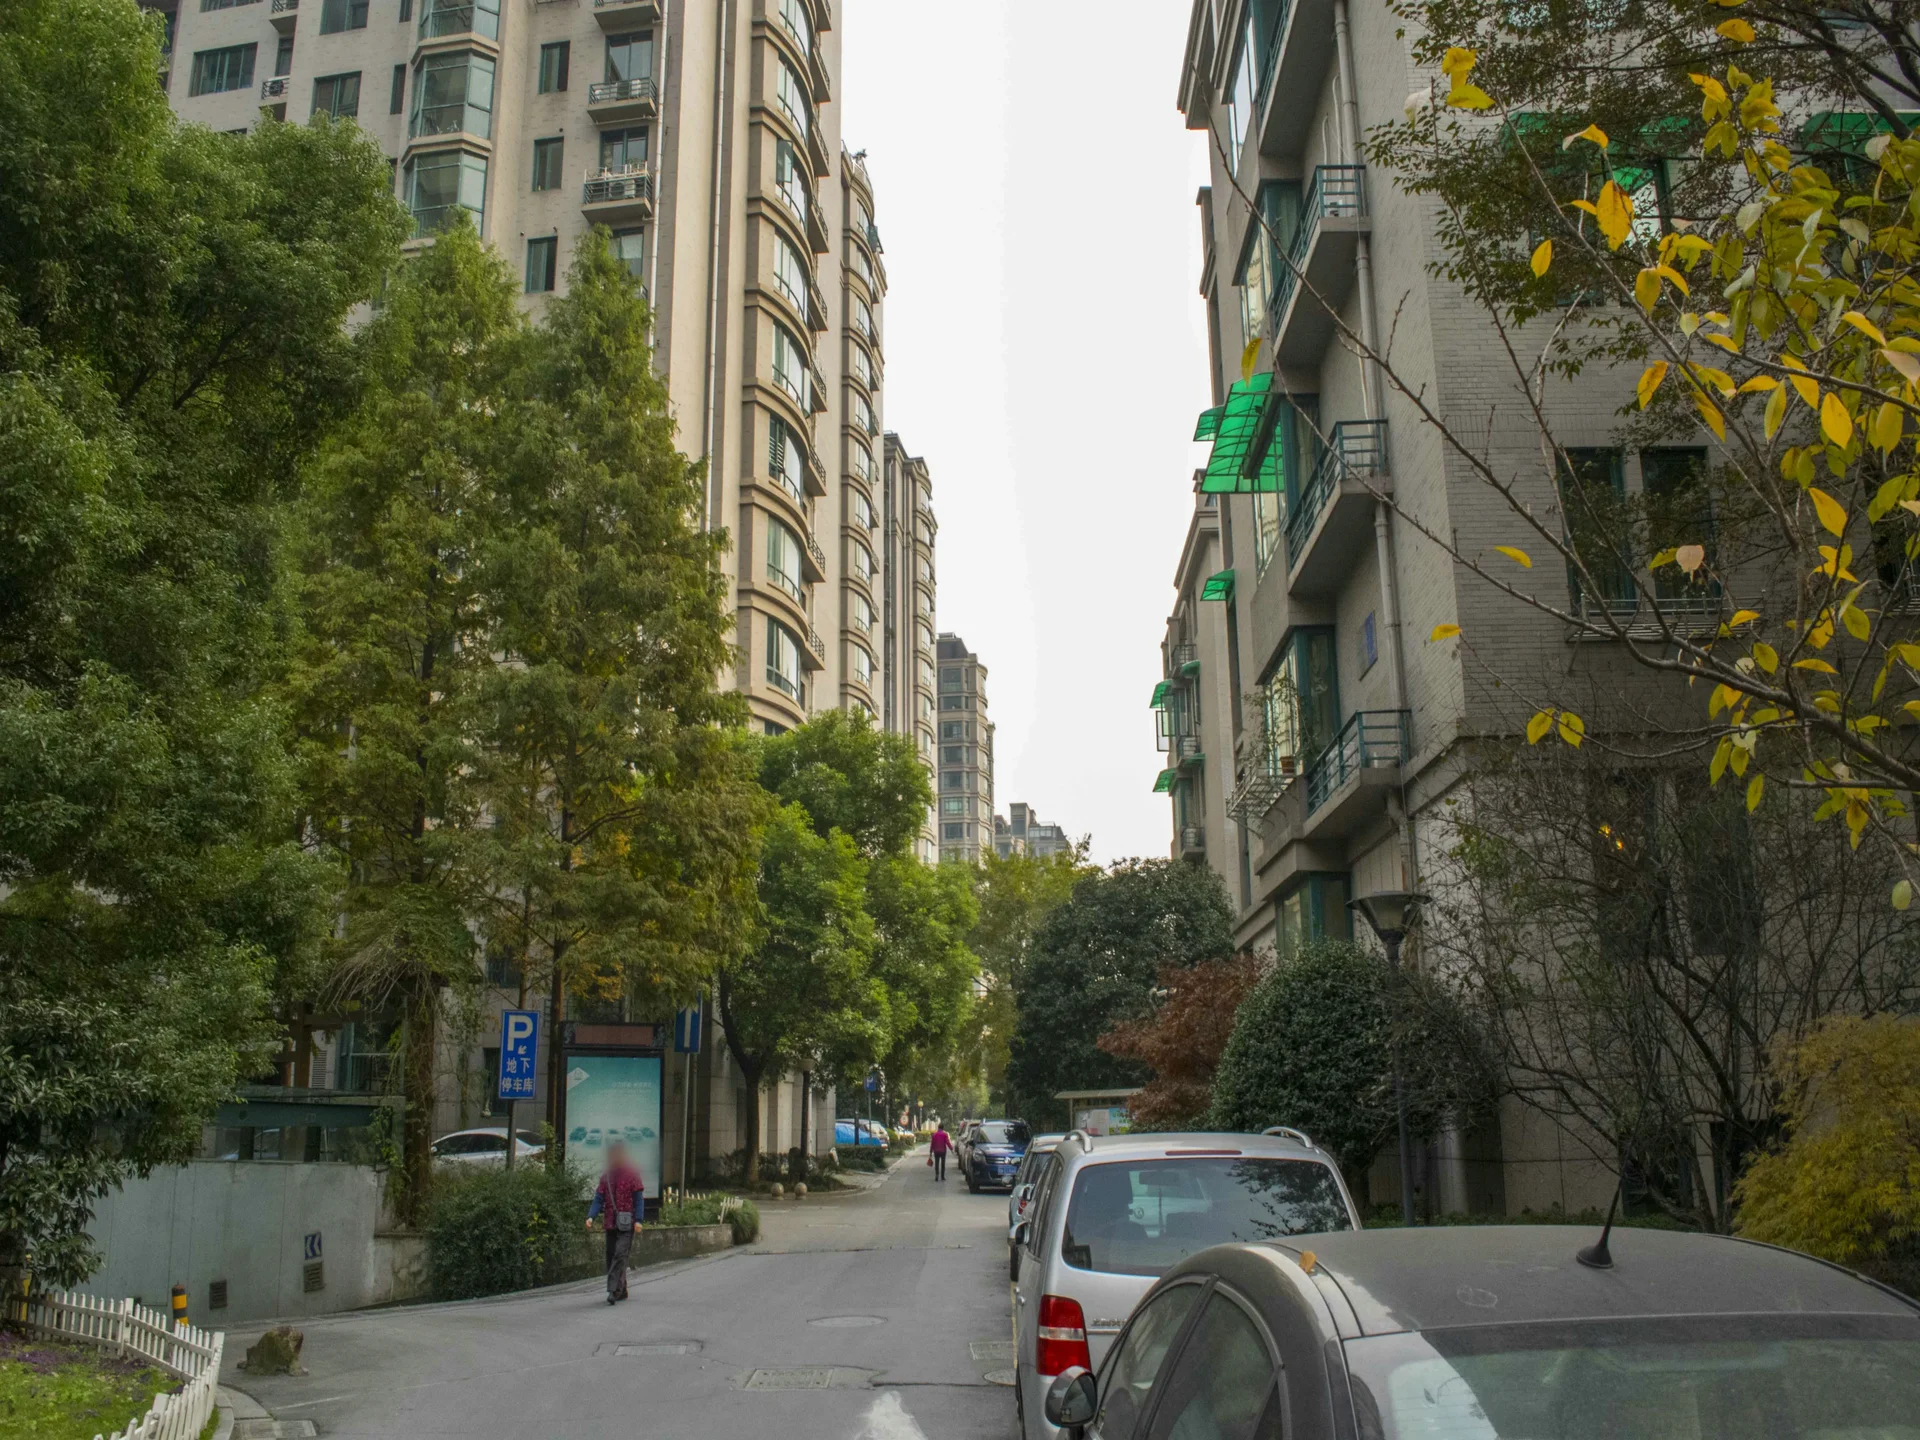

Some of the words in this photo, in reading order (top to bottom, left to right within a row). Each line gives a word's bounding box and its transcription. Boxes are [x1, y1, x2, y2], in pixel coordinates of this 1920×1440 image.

[507, 1015, 533, 1051] P
[506, 1057, 531, 1074] 地下
[502, 1077, 534, 1093] 停车库
